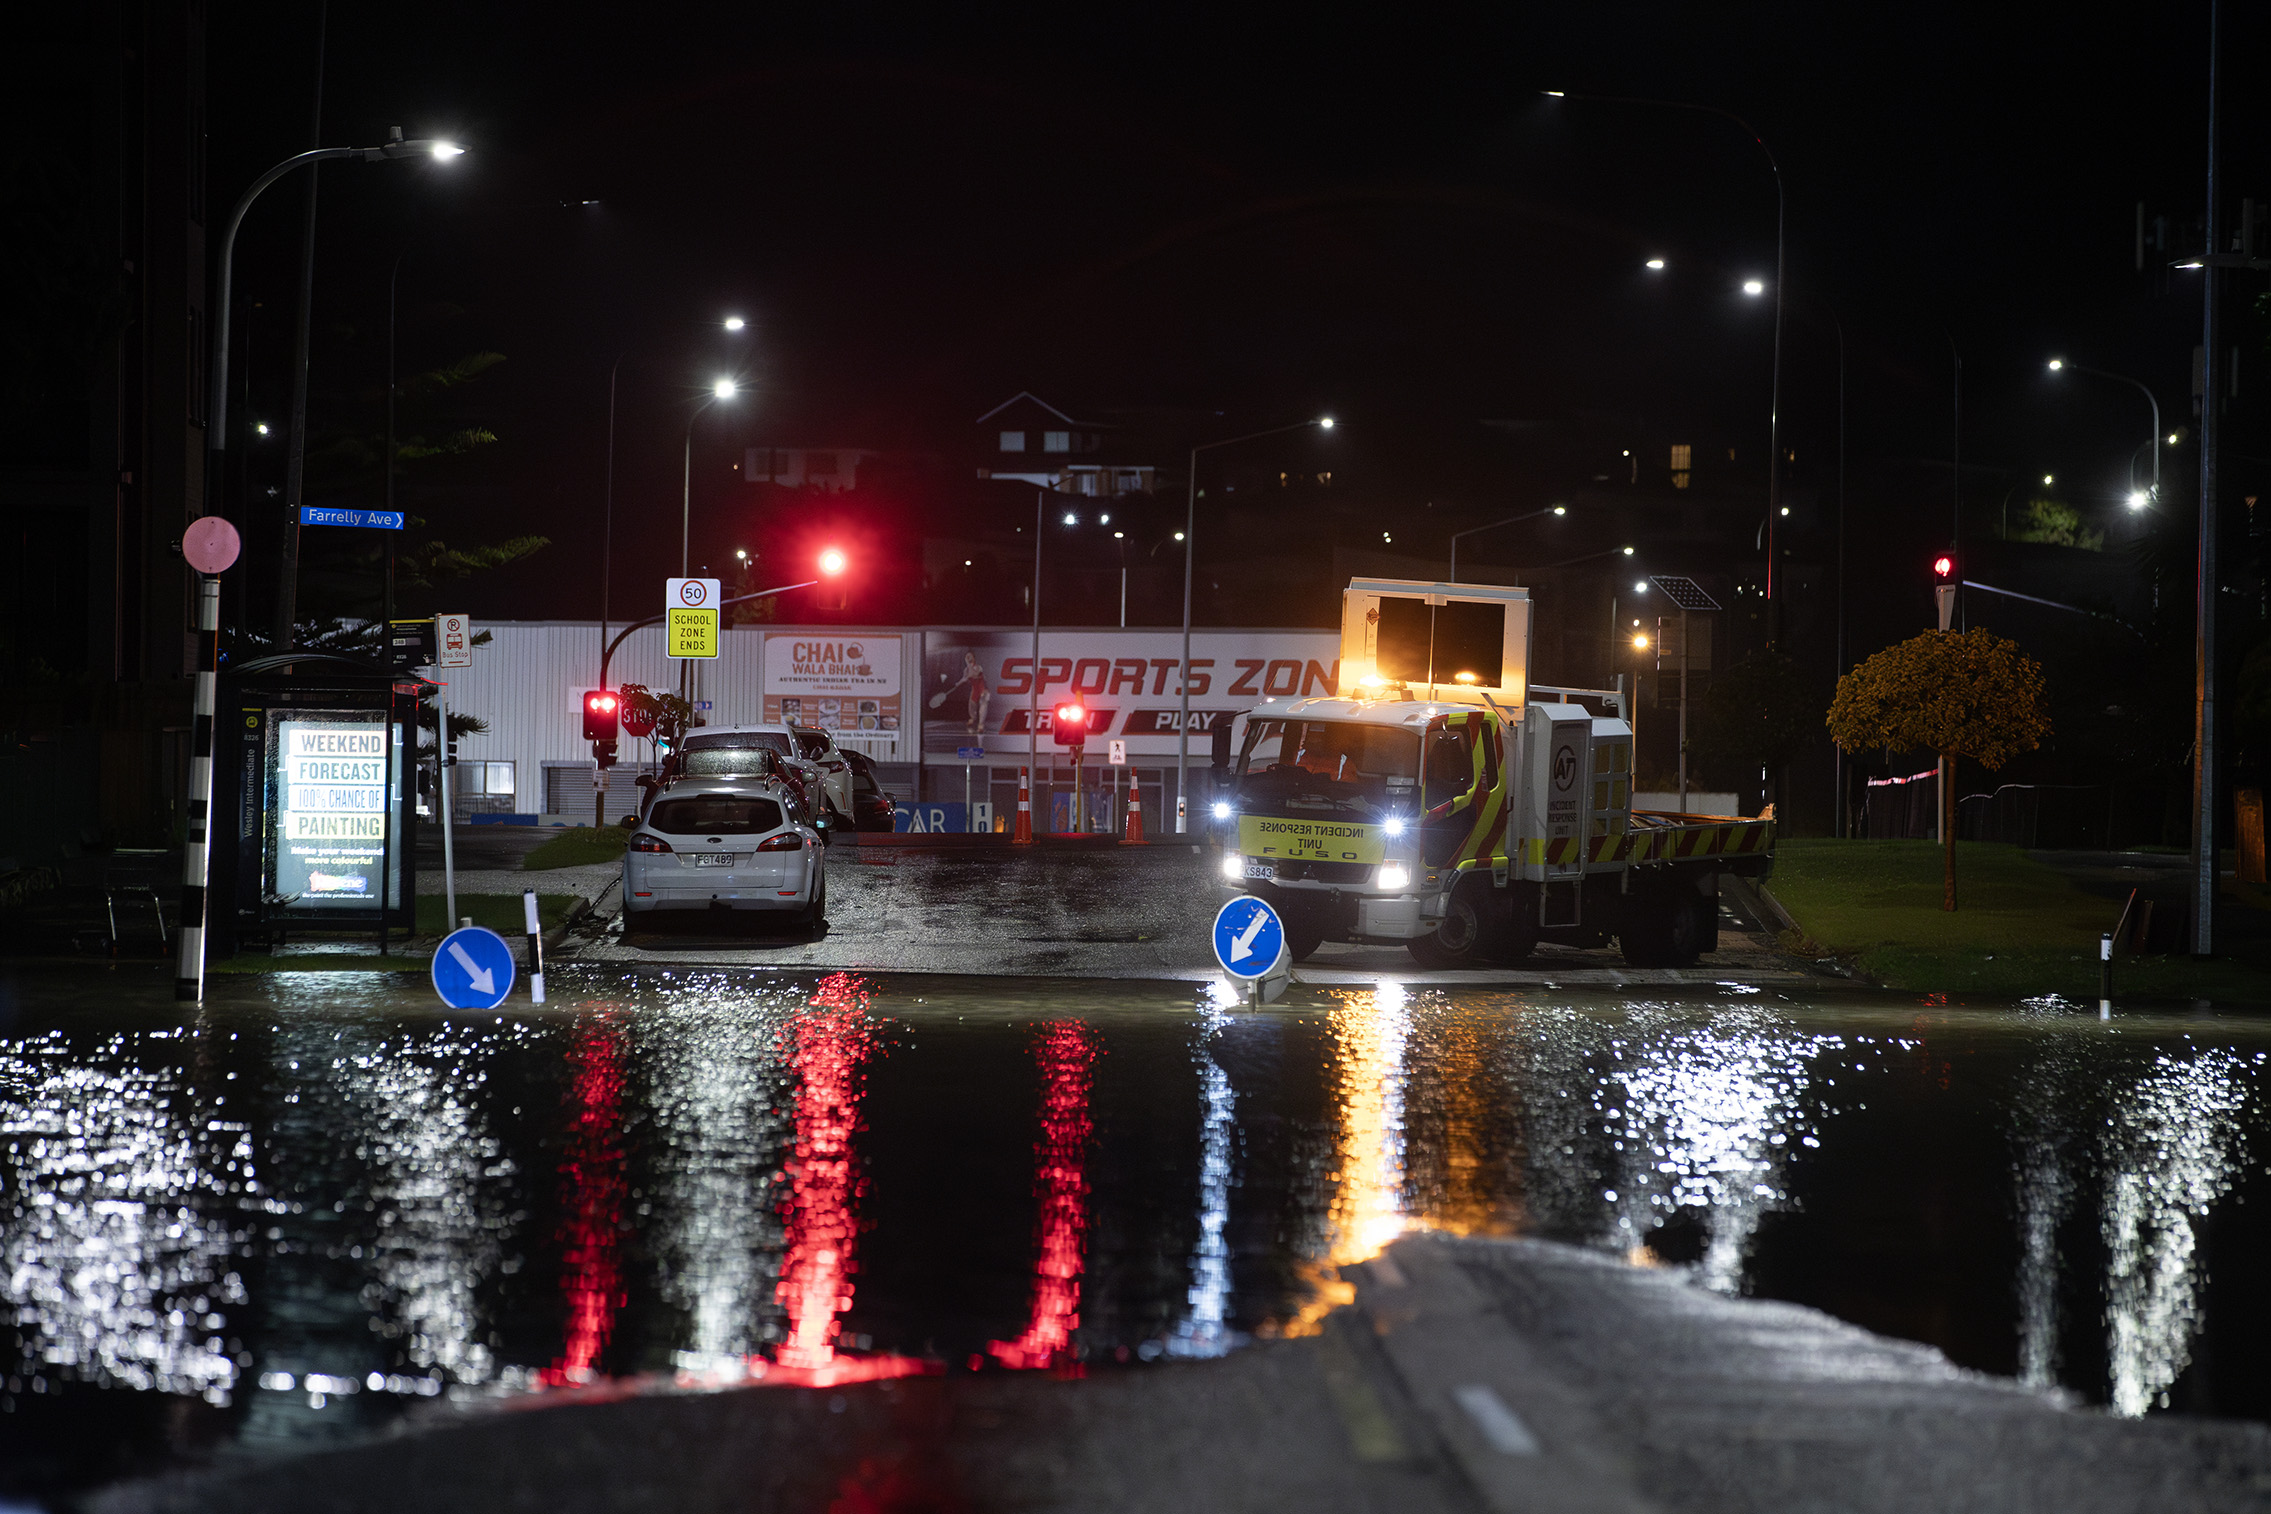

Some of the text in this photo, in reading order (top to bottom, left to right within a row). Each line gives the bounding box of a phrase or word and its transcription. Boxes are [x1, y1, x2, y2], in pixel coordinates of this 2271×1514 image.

[309, 508, 392, 526] Farrelly Ave
[685, 588, 702, 599] 50
[674, 615, 711, 625] SCHOOL
[680, 628, 705, 637] ZONE
[680, 641, 705, 650] ENDS
[793, 642, 843, 663] CHAI
[792, 663, 856, 676] WALA BHAI
[997, 658, 1215, 696] SPORTS
[1024, 712, 1095, 729] TRN
[1155, 712, 1217, 730] PLAY
[301, 735, 381, 753] WEEKEND
[300, 762, 381, 780] FORECAST
[244, 748, 256, 837] Wesley Intermediate
[299, 788, 380, 809] 100% CHANCE OF
[299, 816, 380, 836] PAINTING
[305, 856, 373, 865] more colourful
[1263, 846, 1358, 860] FUSO
